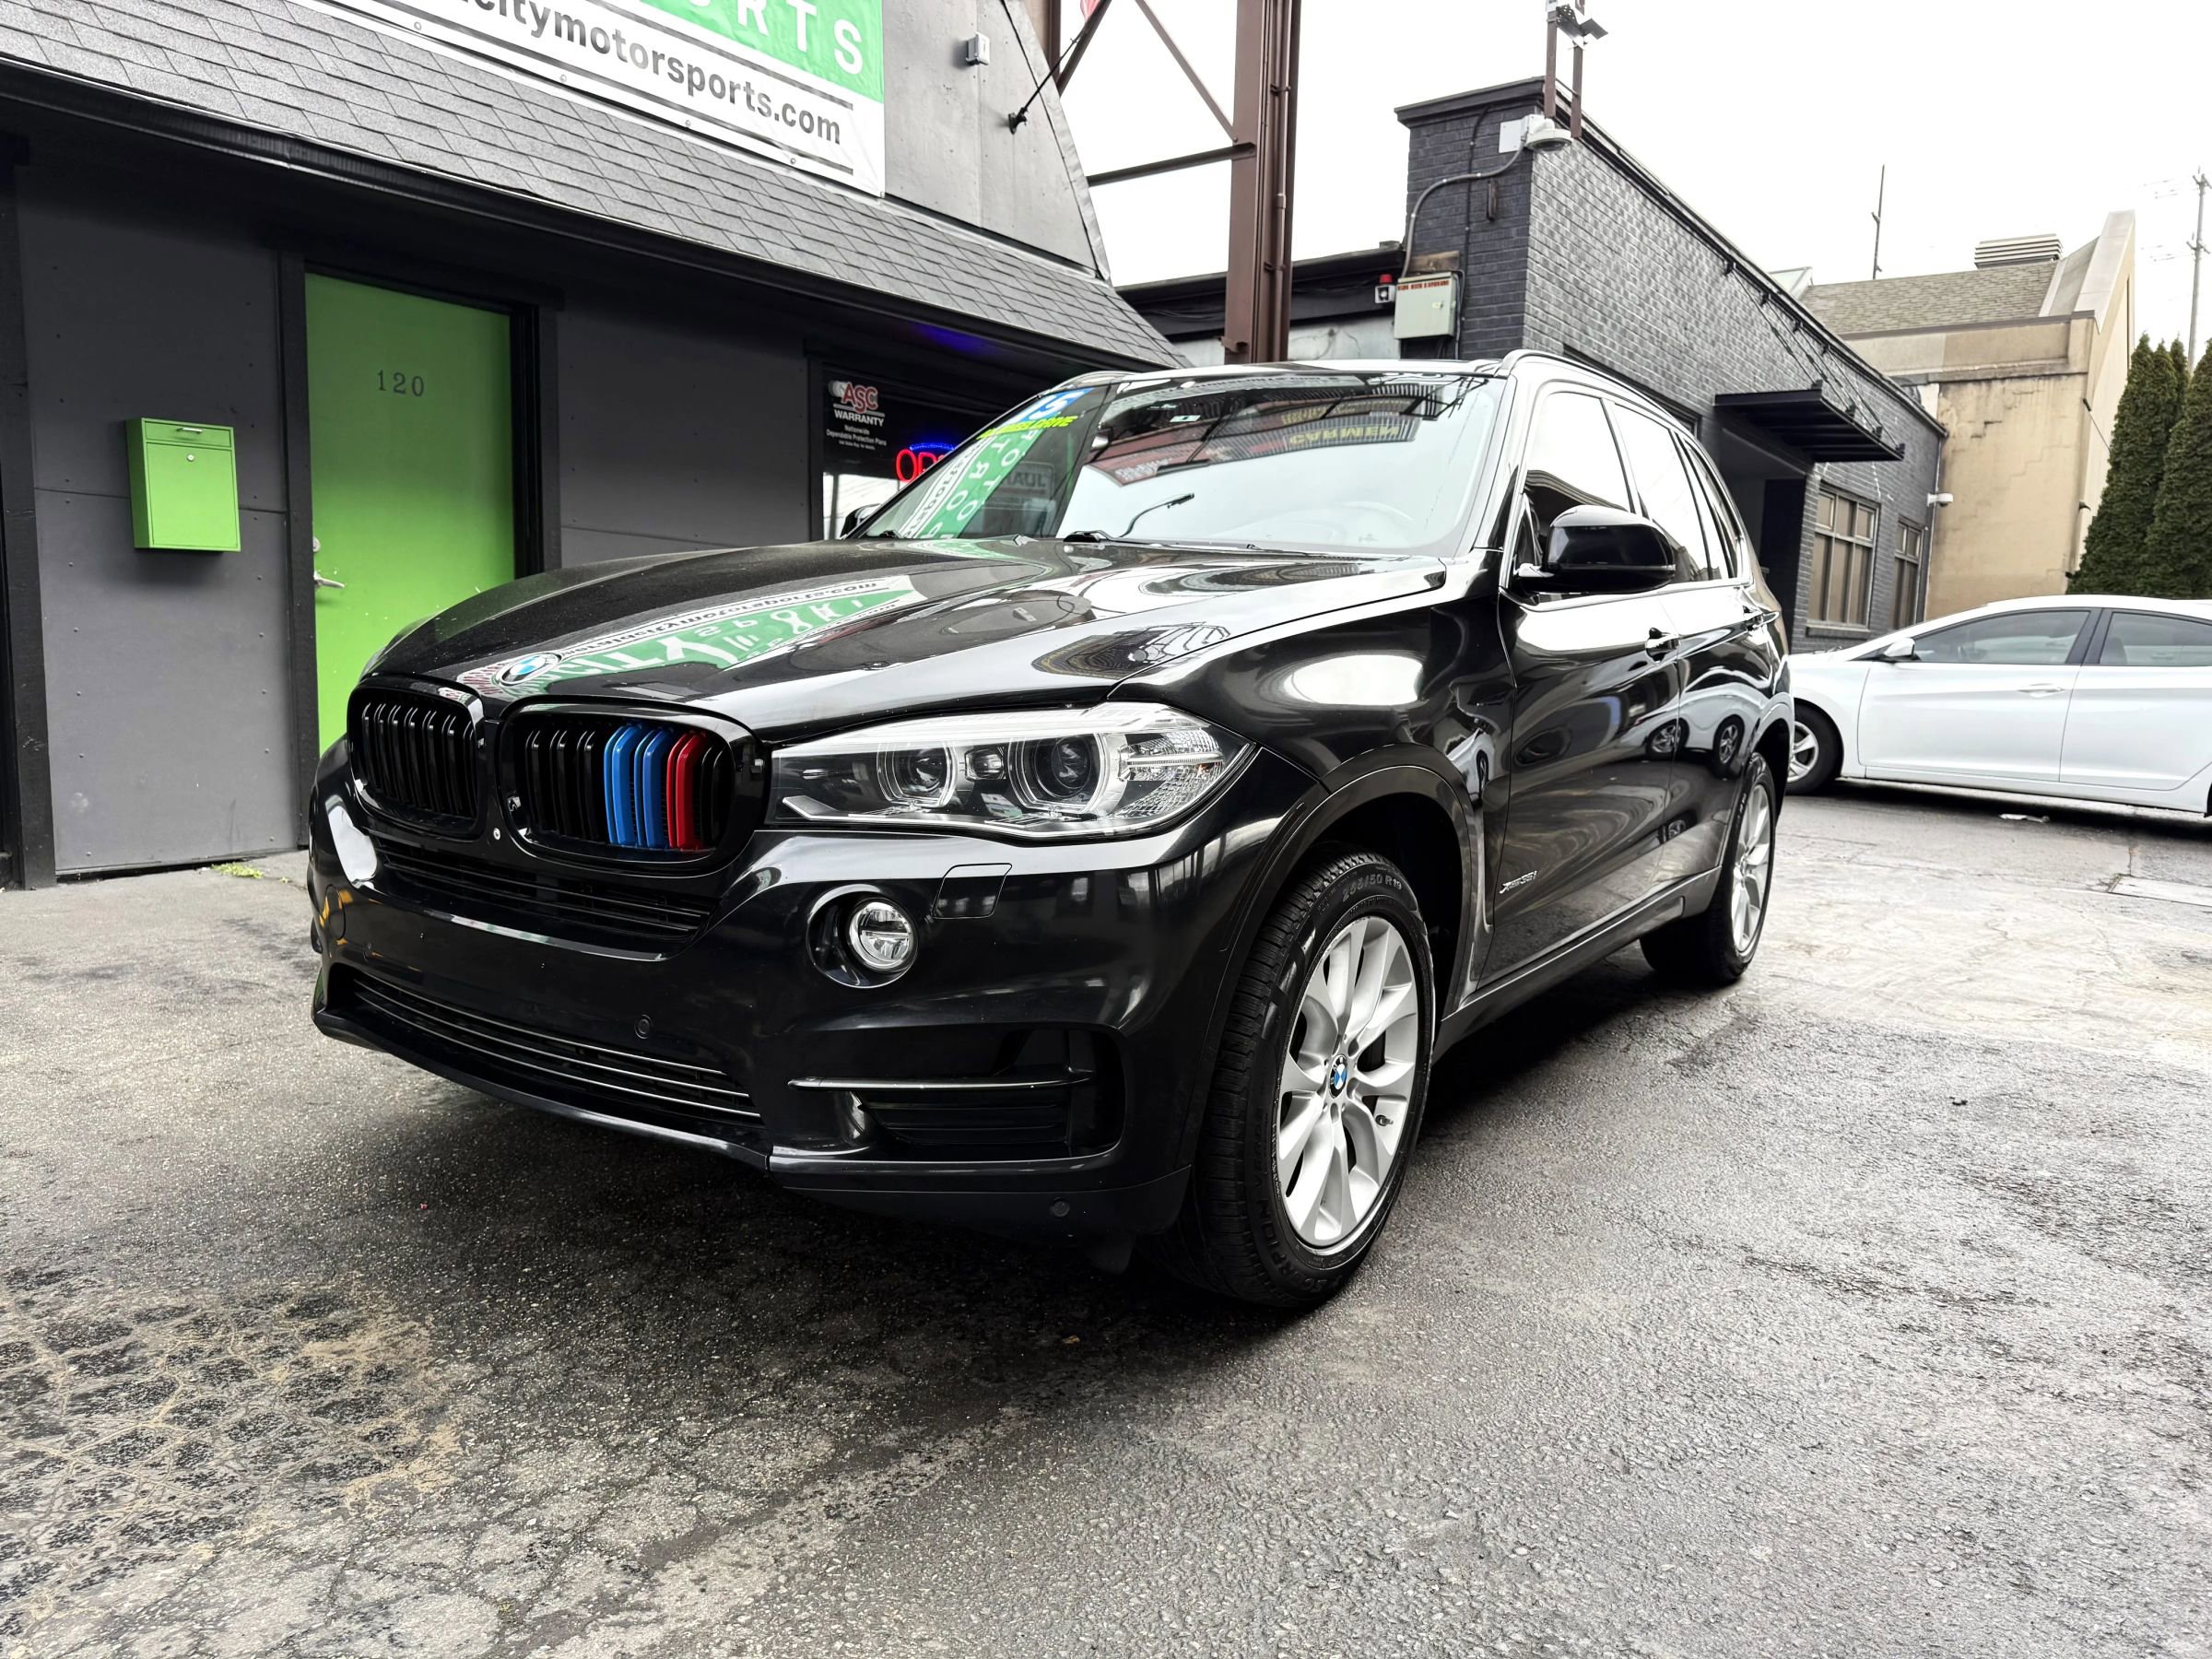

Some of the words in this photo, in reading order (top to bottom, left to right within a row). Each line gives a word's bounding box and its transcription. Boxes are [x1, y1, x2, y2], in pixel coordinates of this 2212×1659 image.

[693, 0, 864, 75] RTS
[377, 370, 425, 397] 120
[841, 382, 878, 413] ASC
[834, 409, 884, 427] WARRANTY
[896, 449, 945, 484] OP
